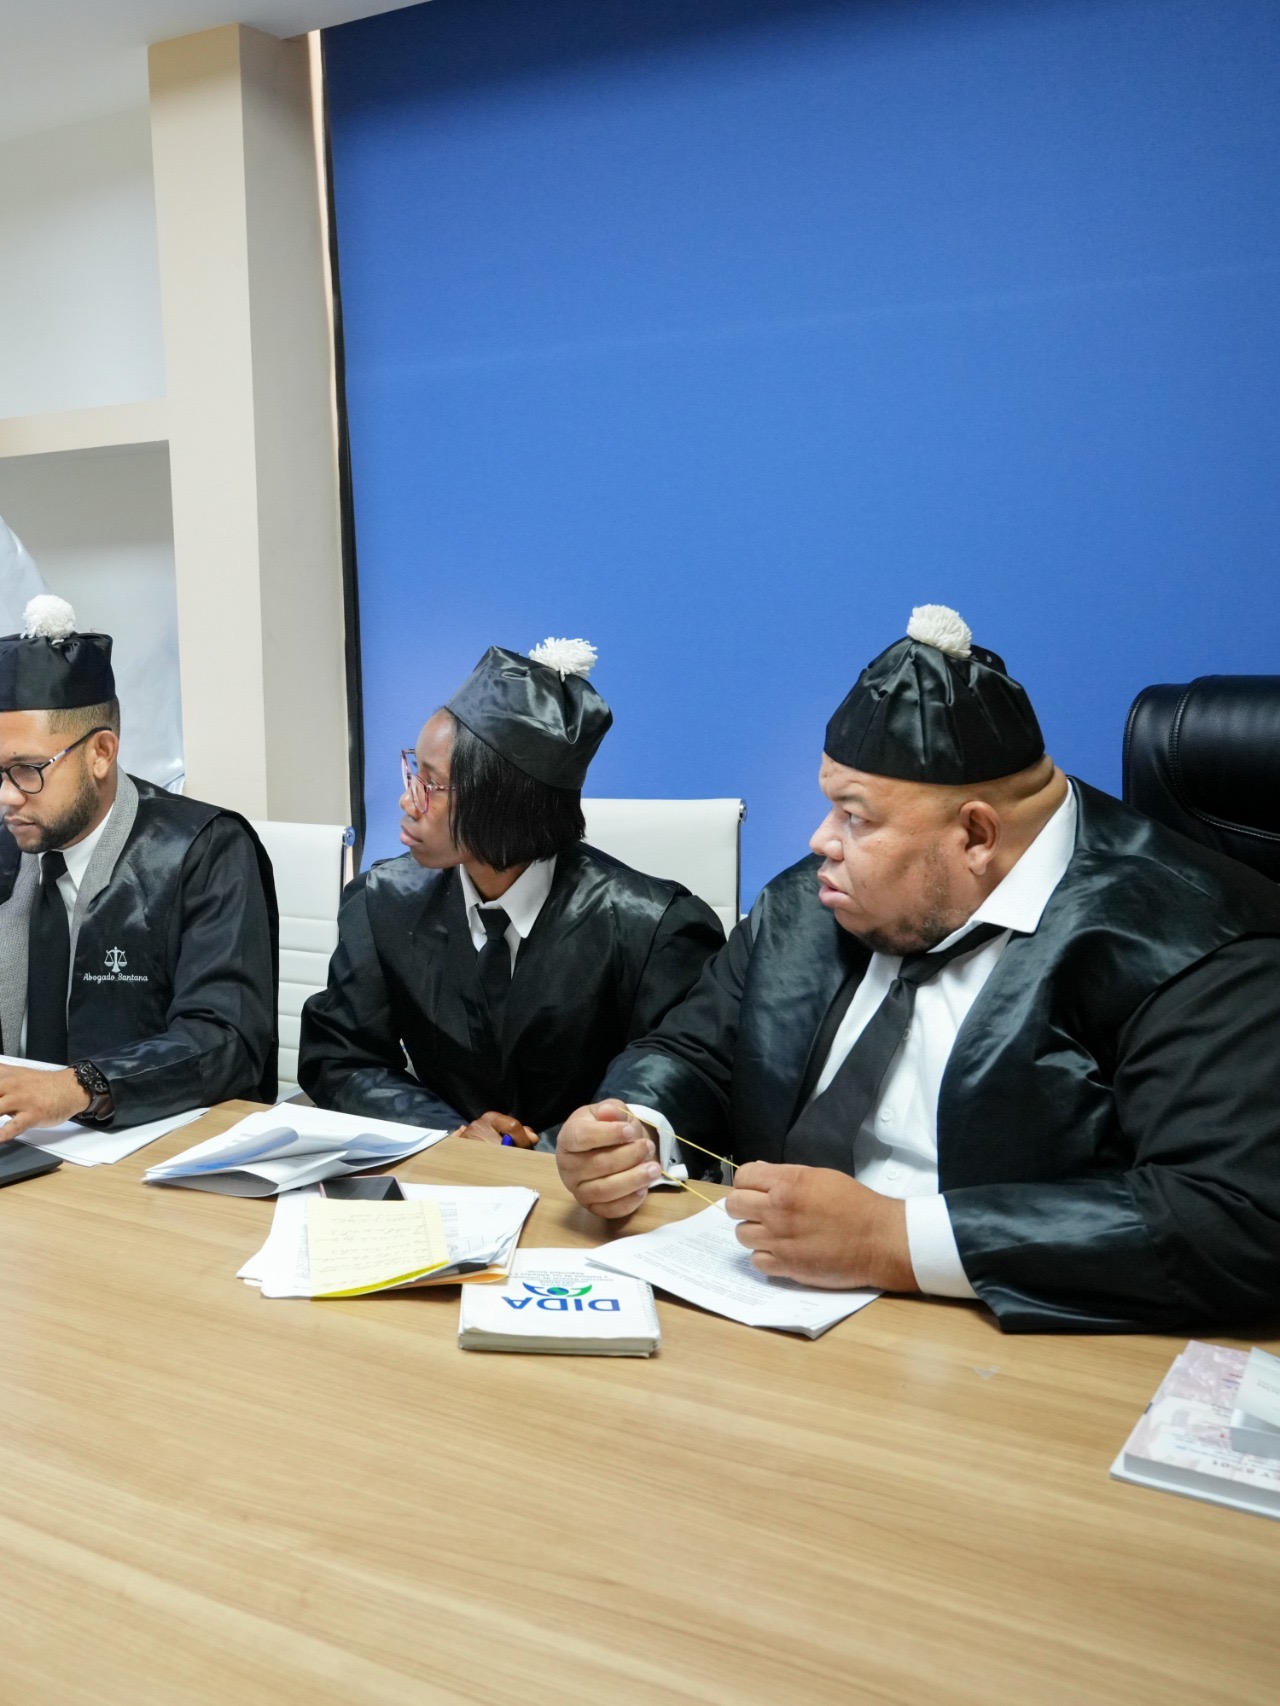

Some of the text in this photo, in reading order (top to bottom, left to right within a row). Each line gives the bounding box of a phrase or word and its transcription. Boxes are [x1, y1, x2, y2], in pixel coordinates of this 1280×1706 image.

[83, 972, 149, 984] Abogado Santana
[501, 1296, 621, 1311] DIDA
